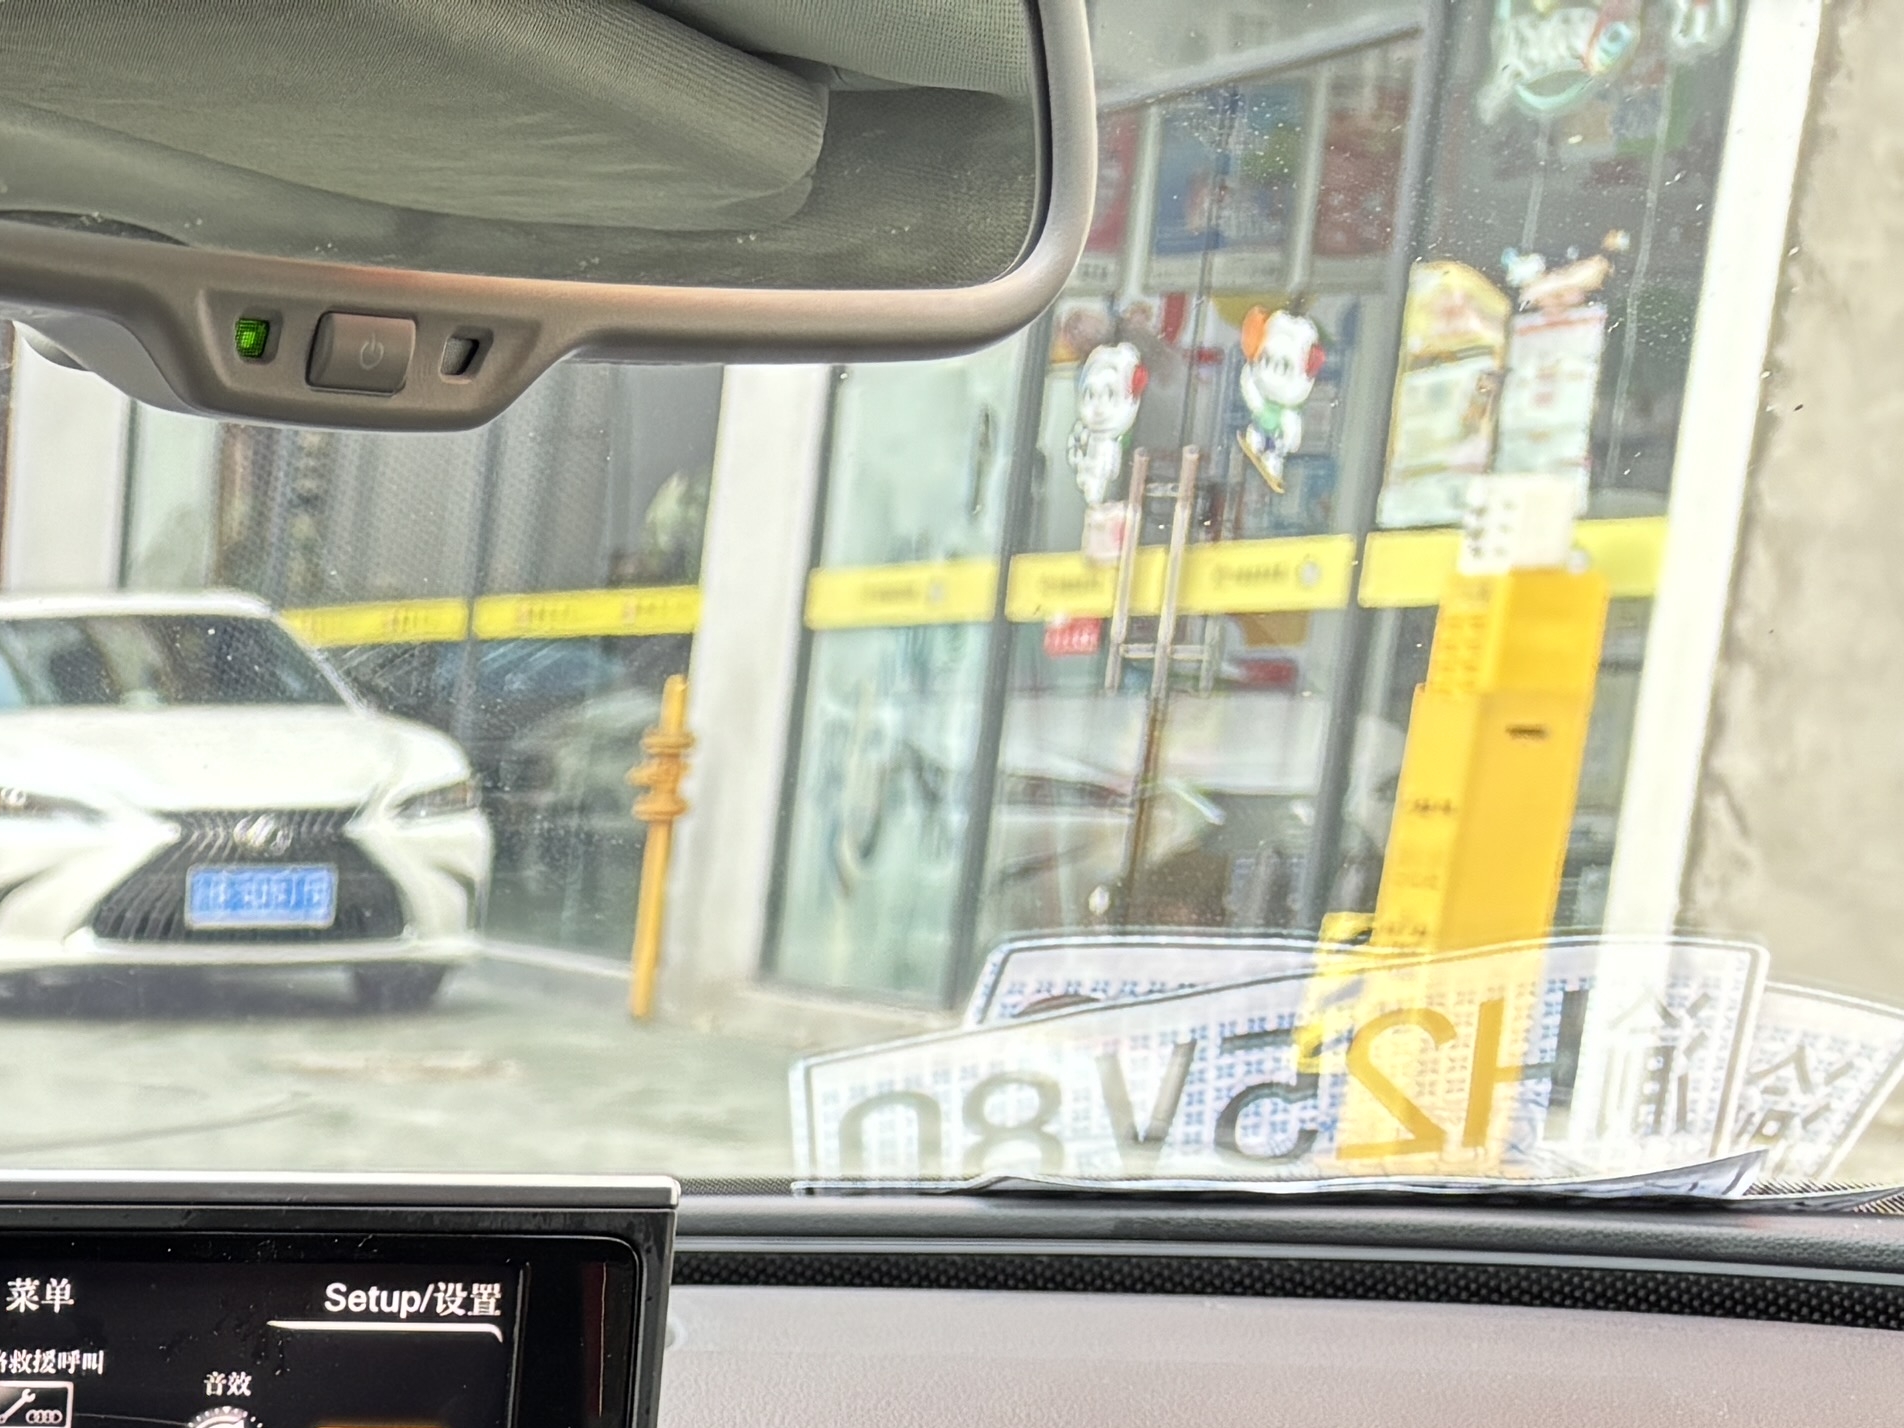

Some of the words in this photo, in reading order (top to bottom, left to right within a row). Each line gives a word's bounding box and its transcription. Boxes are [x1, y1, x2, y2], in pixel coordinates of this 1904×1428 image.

[6, 1277, 75, 1313] 菜单
[324, 1281, 503, 1319] Setup/设置
[203, 1371, 252, 1397] 音效
